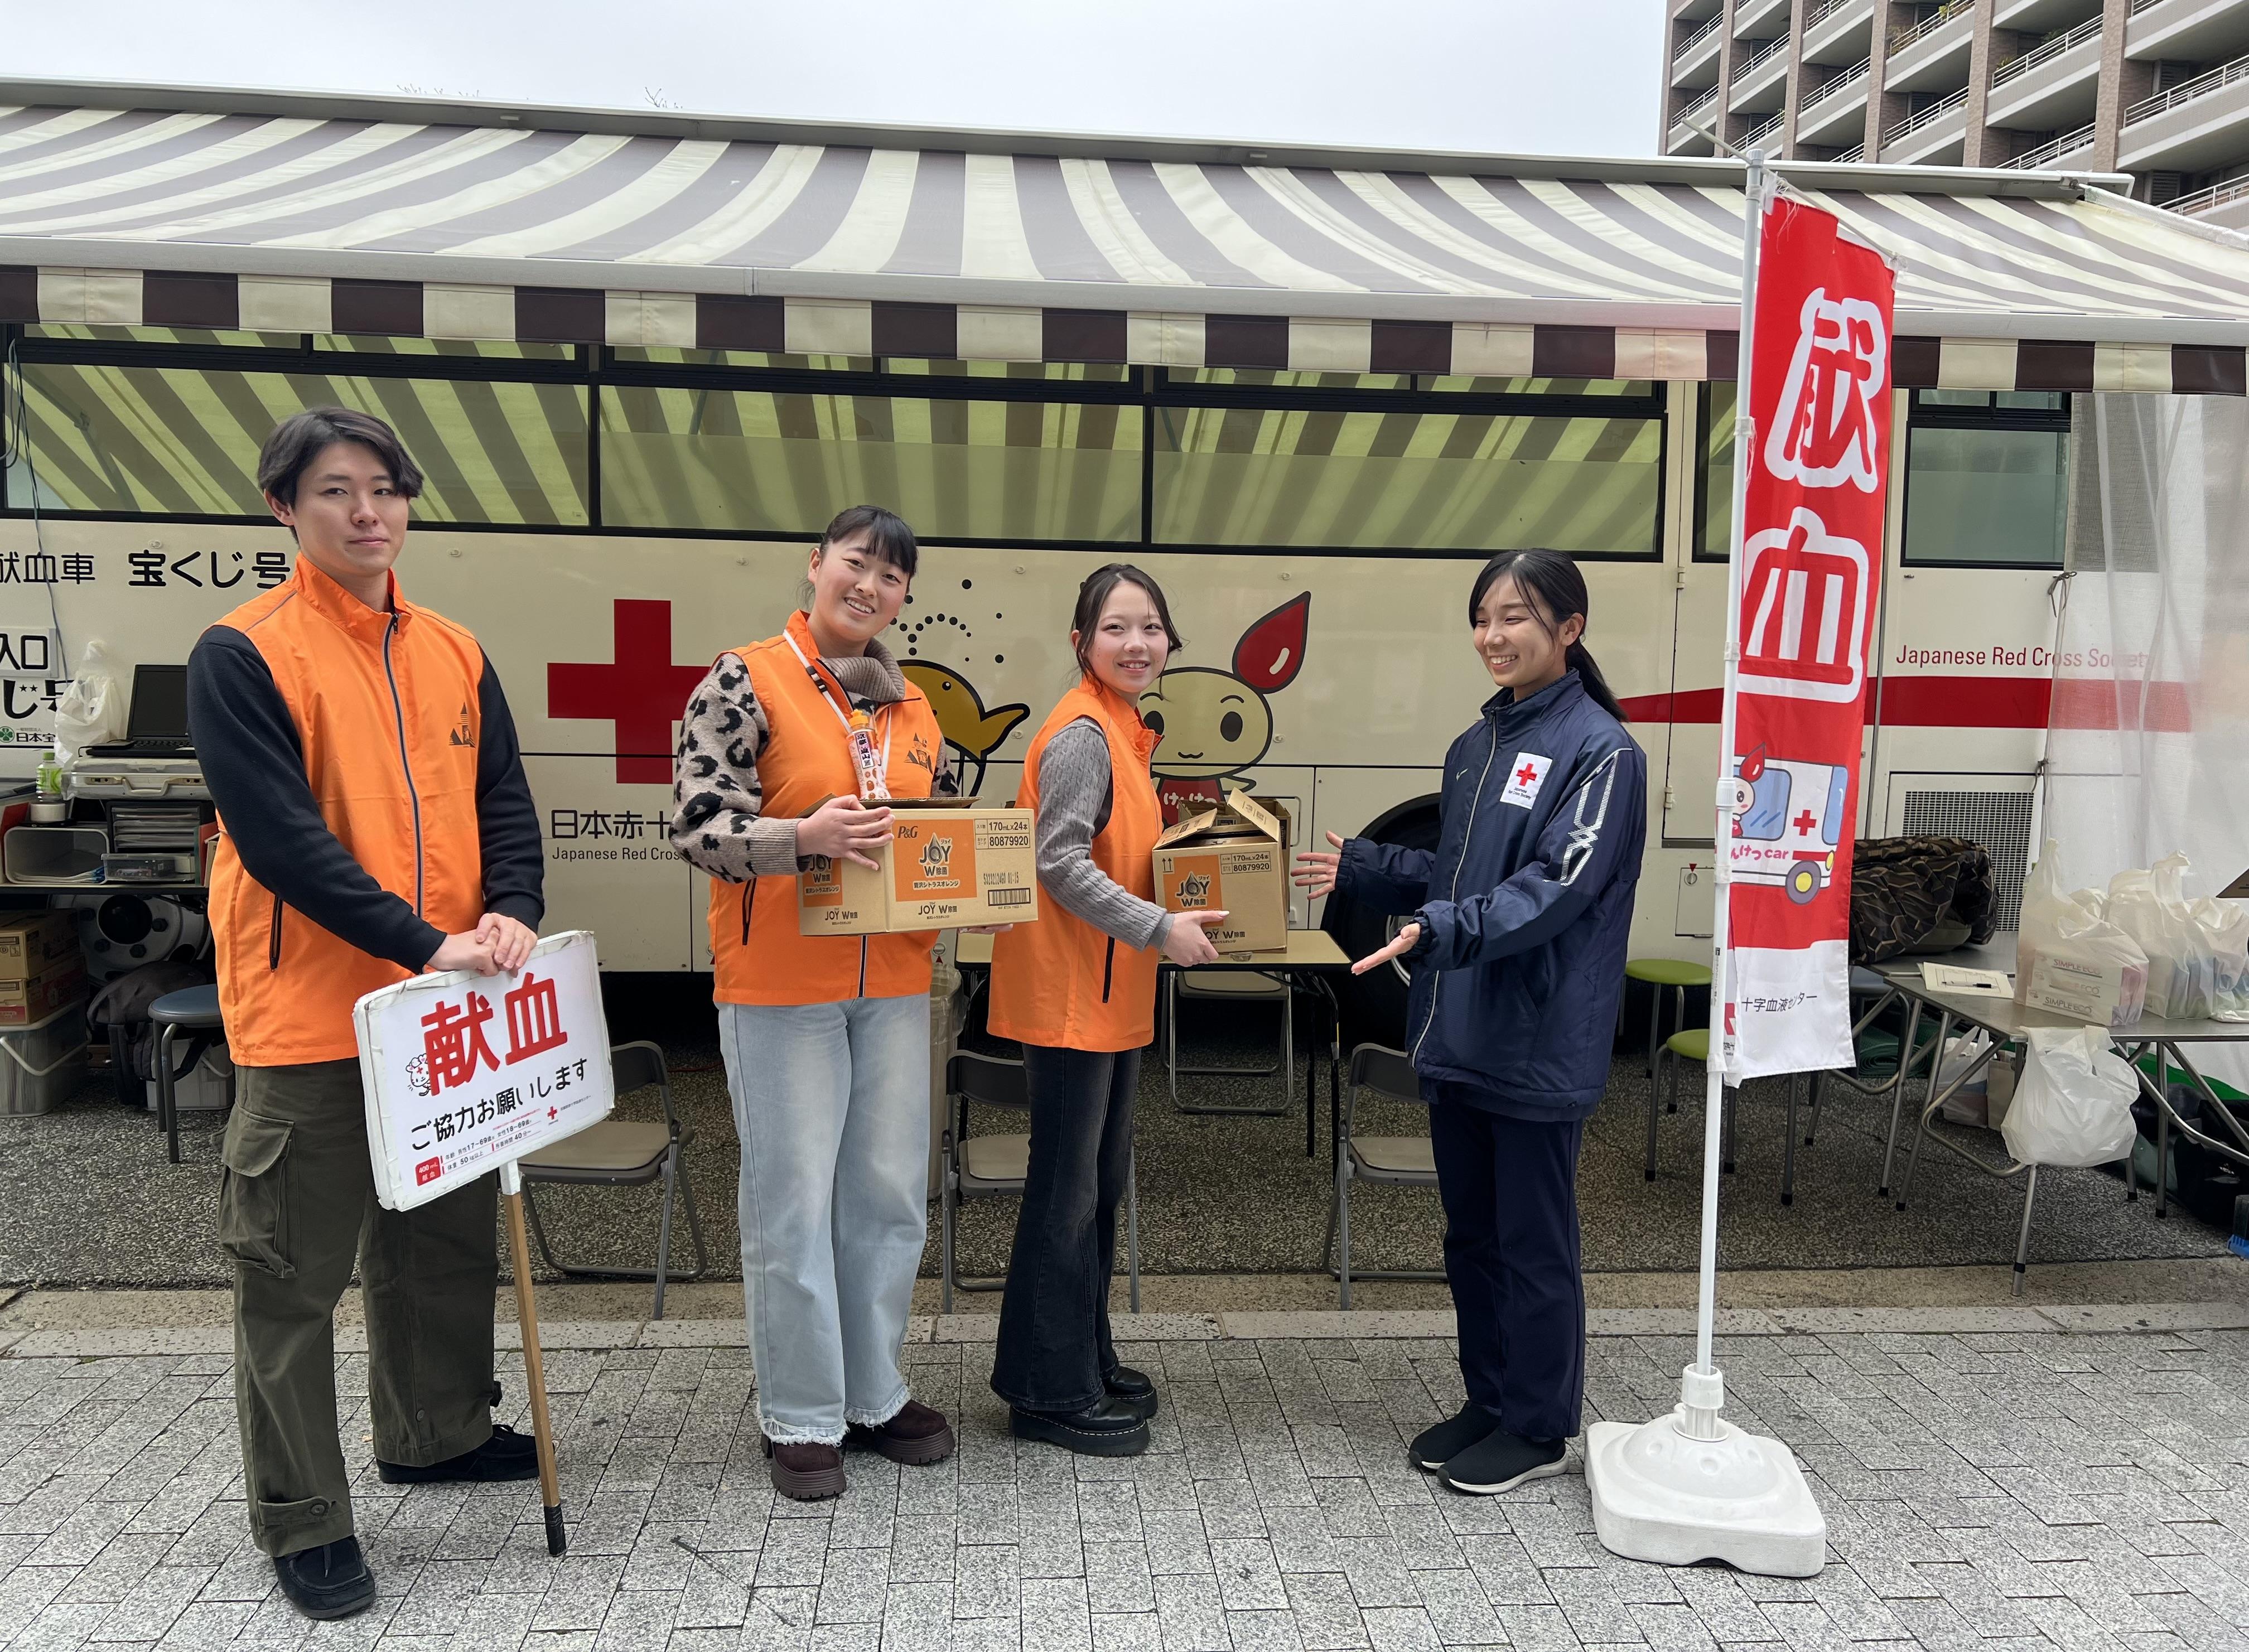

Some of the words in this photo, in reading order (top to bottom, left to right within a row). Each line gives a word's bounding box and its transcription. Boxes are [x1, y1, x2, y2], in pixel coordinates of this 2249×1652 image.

[128, 549, 291, 589] 宝くじ号
[1896, 644, 1986, 668] Japanese
[1992, 646, 2026, 665] Red
[2032, 647, 2082, 667] Cross
[16, 732, 56, 743] 日本宝
[551, 810, 672, 839] 日本赤十
[897, 825, 918, 838] P&G
[990, 835, 1029, 847] 80879920
[552, 847, 617, 862] Japanese
[622, 848, 646, 860] Red
[920, 846, 951, 863] JOY
[810, 854, 832, 872] JOY
[1233, 863, 1270, 872] 80879920
[924, 865, 948, 876] W除菌
[1176, 881, 1210, 897] JOY
[1181, 898, 1206, 907] W除菌
[825, 911, 839, 920] JOY
[918, 905, 936, 915] JOY
[1204, 931, 1219, 940] OY
[2053, 959, 2082, 970] SIMPLE
[2044, 997, 2072, 1009] SIMPLE
[421, 972, 568, 1096] 献血
[411, 1057, 588, 1150] ご協力お願いします
